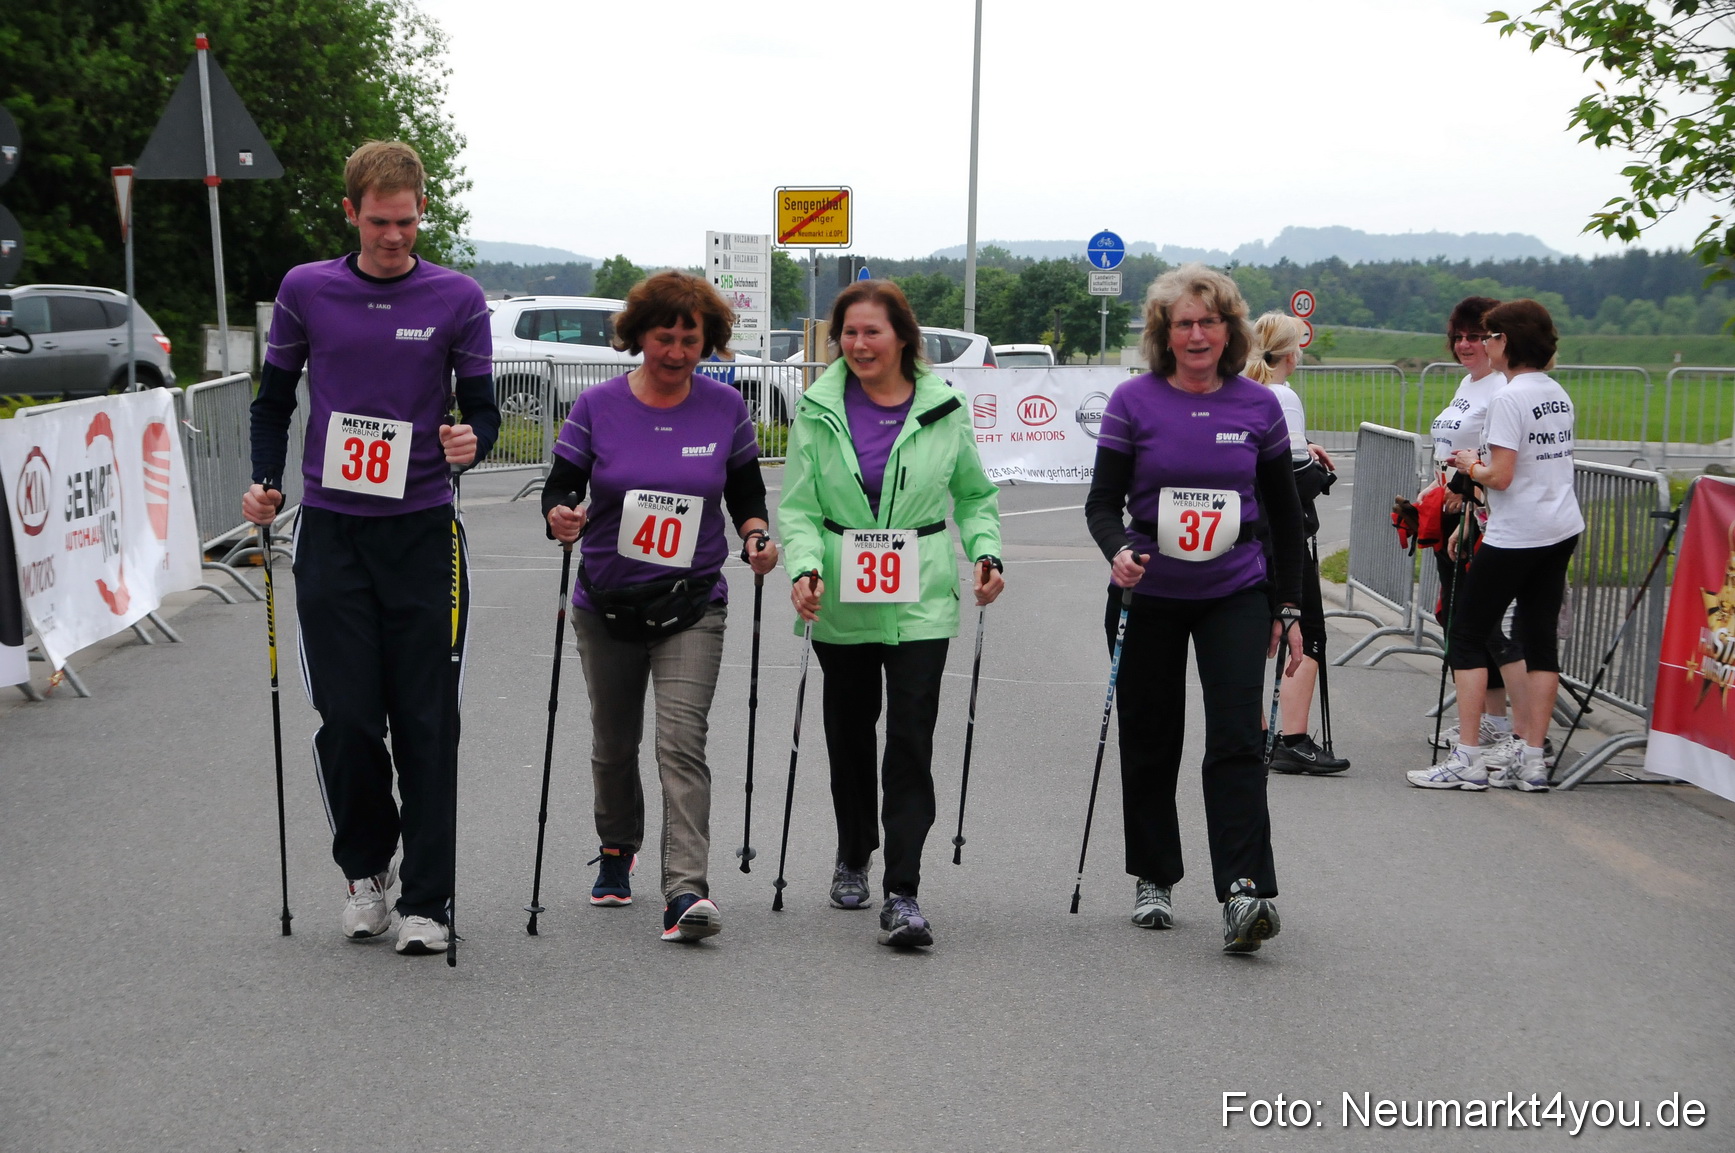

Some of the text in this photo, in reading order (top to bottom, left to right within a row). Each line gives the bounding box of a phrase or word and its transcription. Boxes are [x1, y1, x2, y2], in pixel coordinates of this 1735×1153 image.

[784, 196, 842, 214] Sengenthal
[791, 214, 834, 225] am Anger
[797, 230, 823, 238] Neumarkt
[721, 275, 733, 288] SHB
[1296, 298, 1309, 310] 60
[1024, 403, 1049, 418] KIA
[342, 417, 379, 431] MEYER
[342, 427, 379, 438] WERBUNG
[976, 434, 1003, 442] EAT
[1010, 430, 1065, 442] KIA MOTORS
[1529, 432, 1556, 444] POWR
[341, 437, 391, 483] 38
[1027, 465, 1095, 480] www.gerhart-jae
[24, 470, 46, 516] KIA
[1172, 491, 1210, 501] MEYER
[637, 494, 674, 506] MEYER
[1172, 500, 1210, 508] WERBUNG
[637, 501, 674, 512] WERBUNG
[632, 514, 682, 558] 40
[1178, 509, 1222, 552] 37
[854, 533, 889, 542] MEYER
[856, 551, 900, 594] 39
